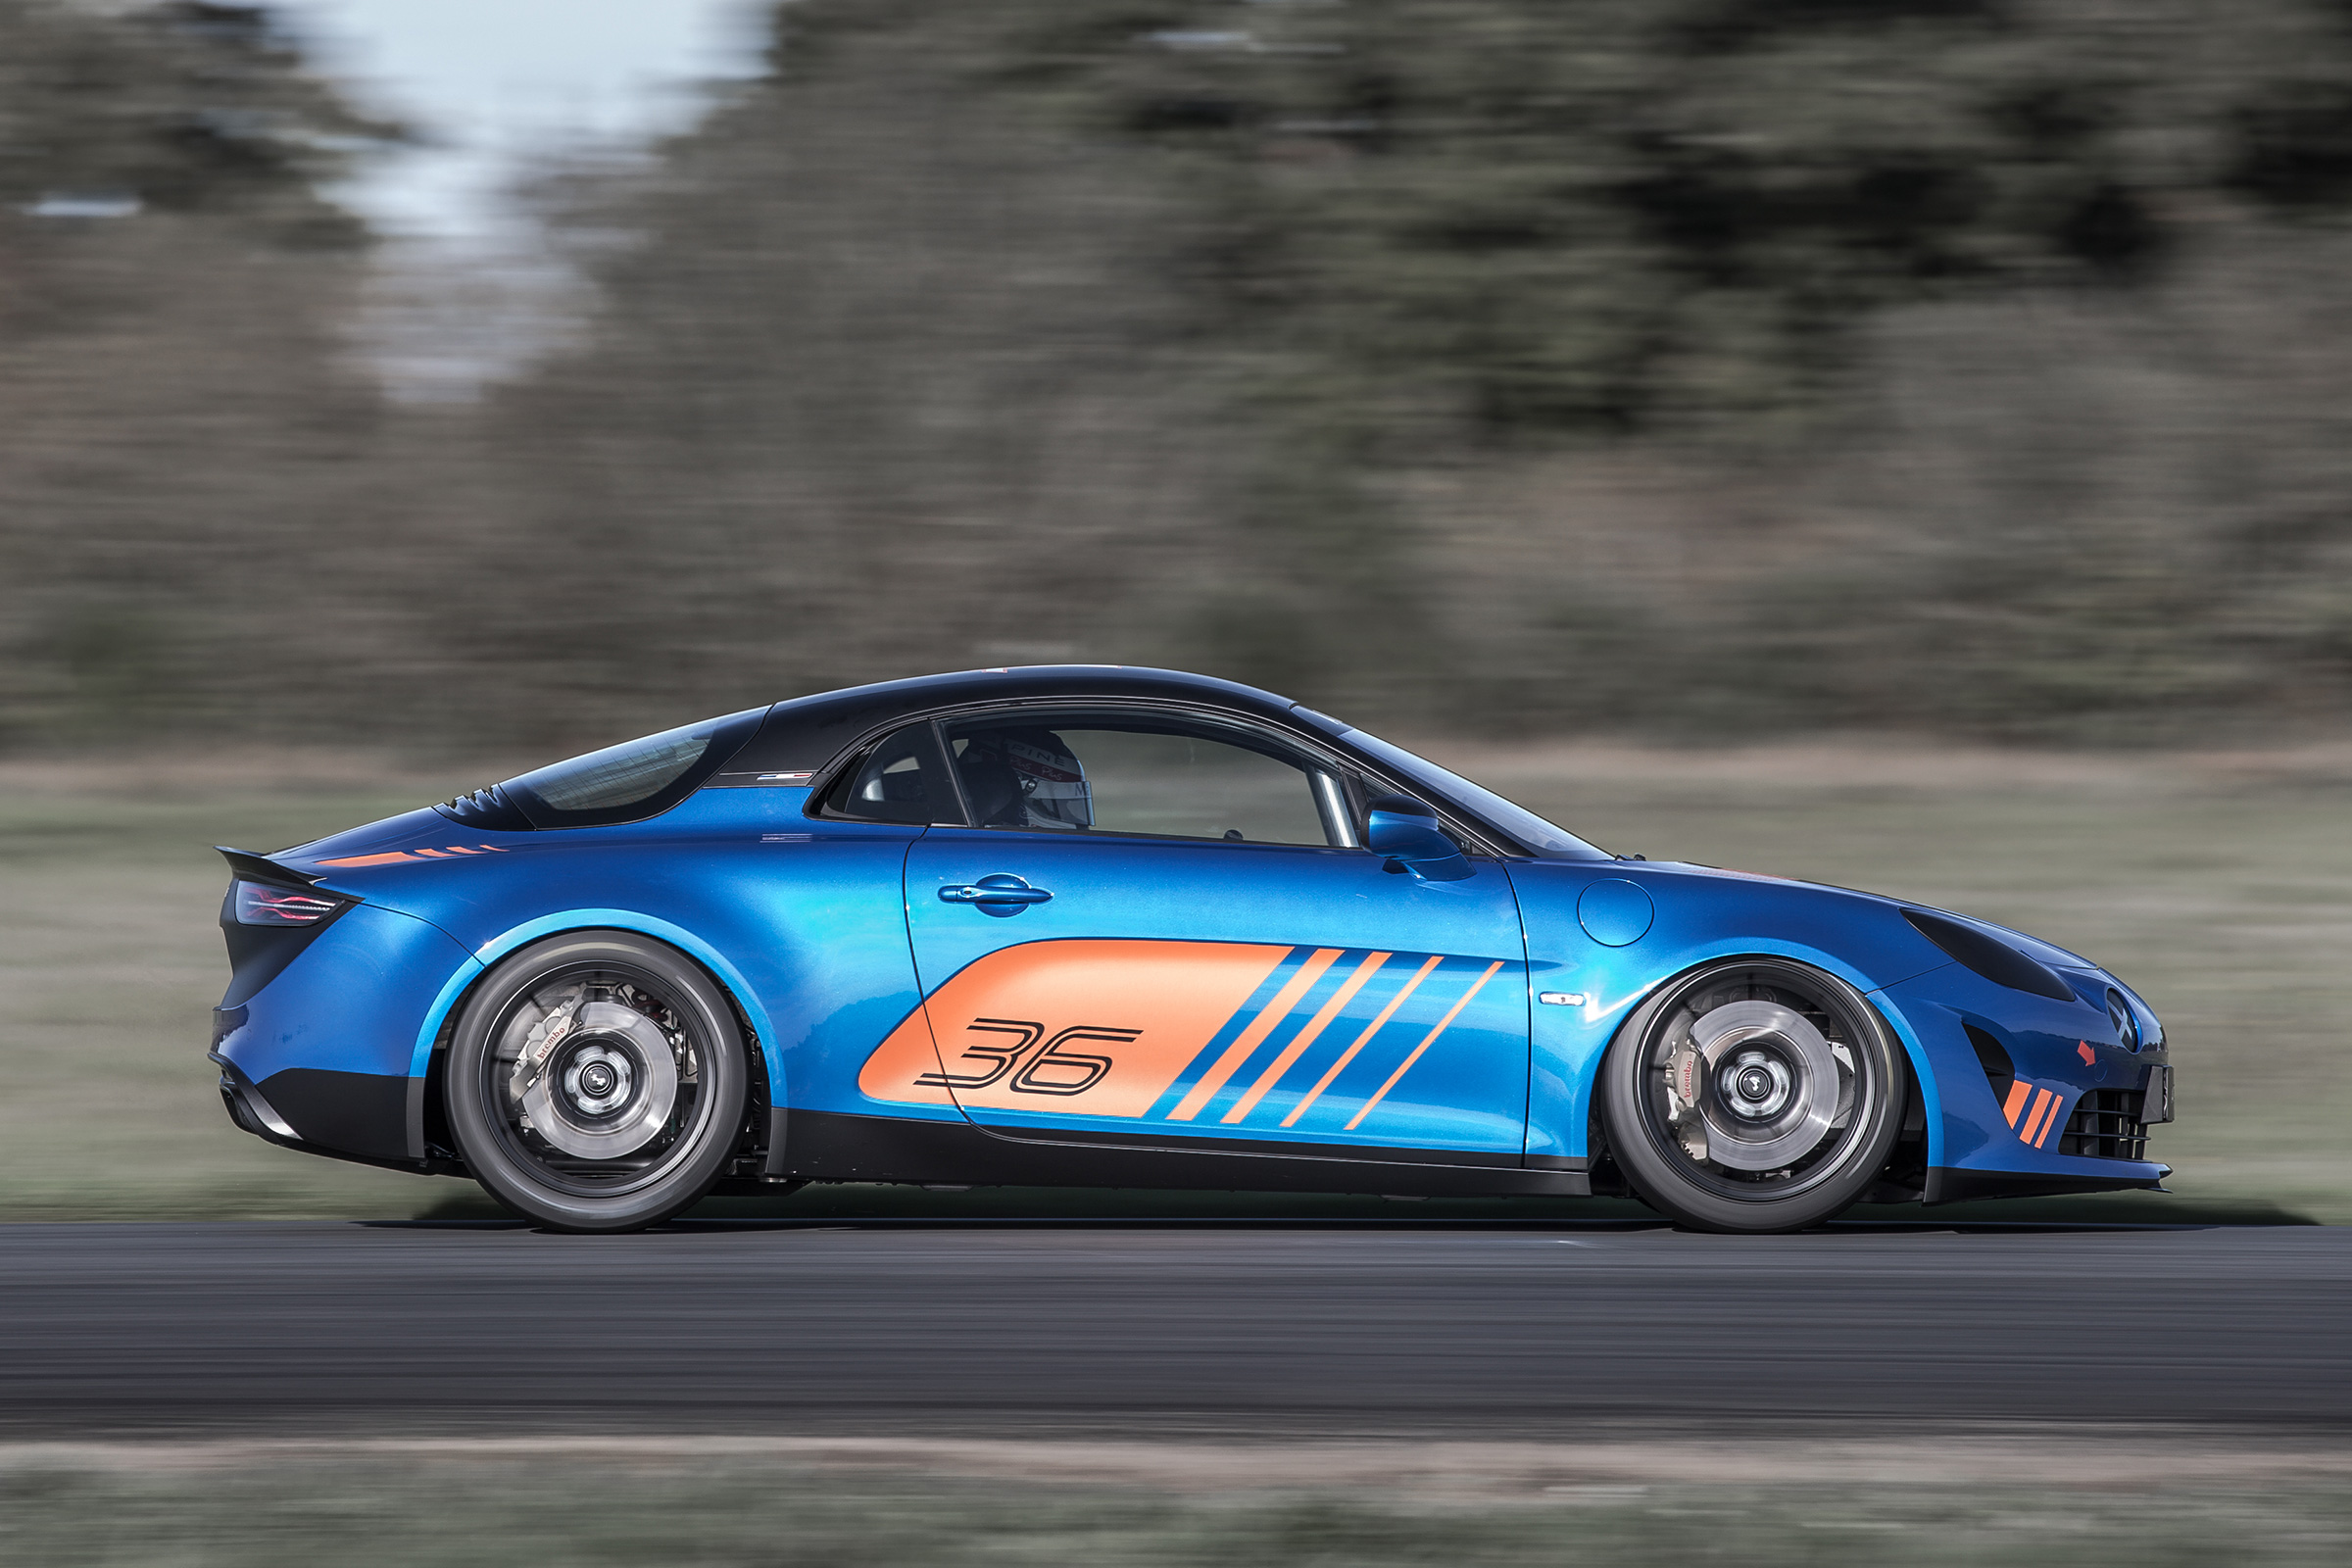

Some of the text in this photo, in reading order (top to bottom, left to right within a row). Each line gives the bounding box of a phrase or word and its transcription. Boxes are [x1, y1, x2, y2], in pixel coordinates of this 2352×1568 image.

[537, 1027, 565, 1059] brembo
[912, 1017, 1144, 1096] 36
[1684, 1060, 1692, 1098] brembo
